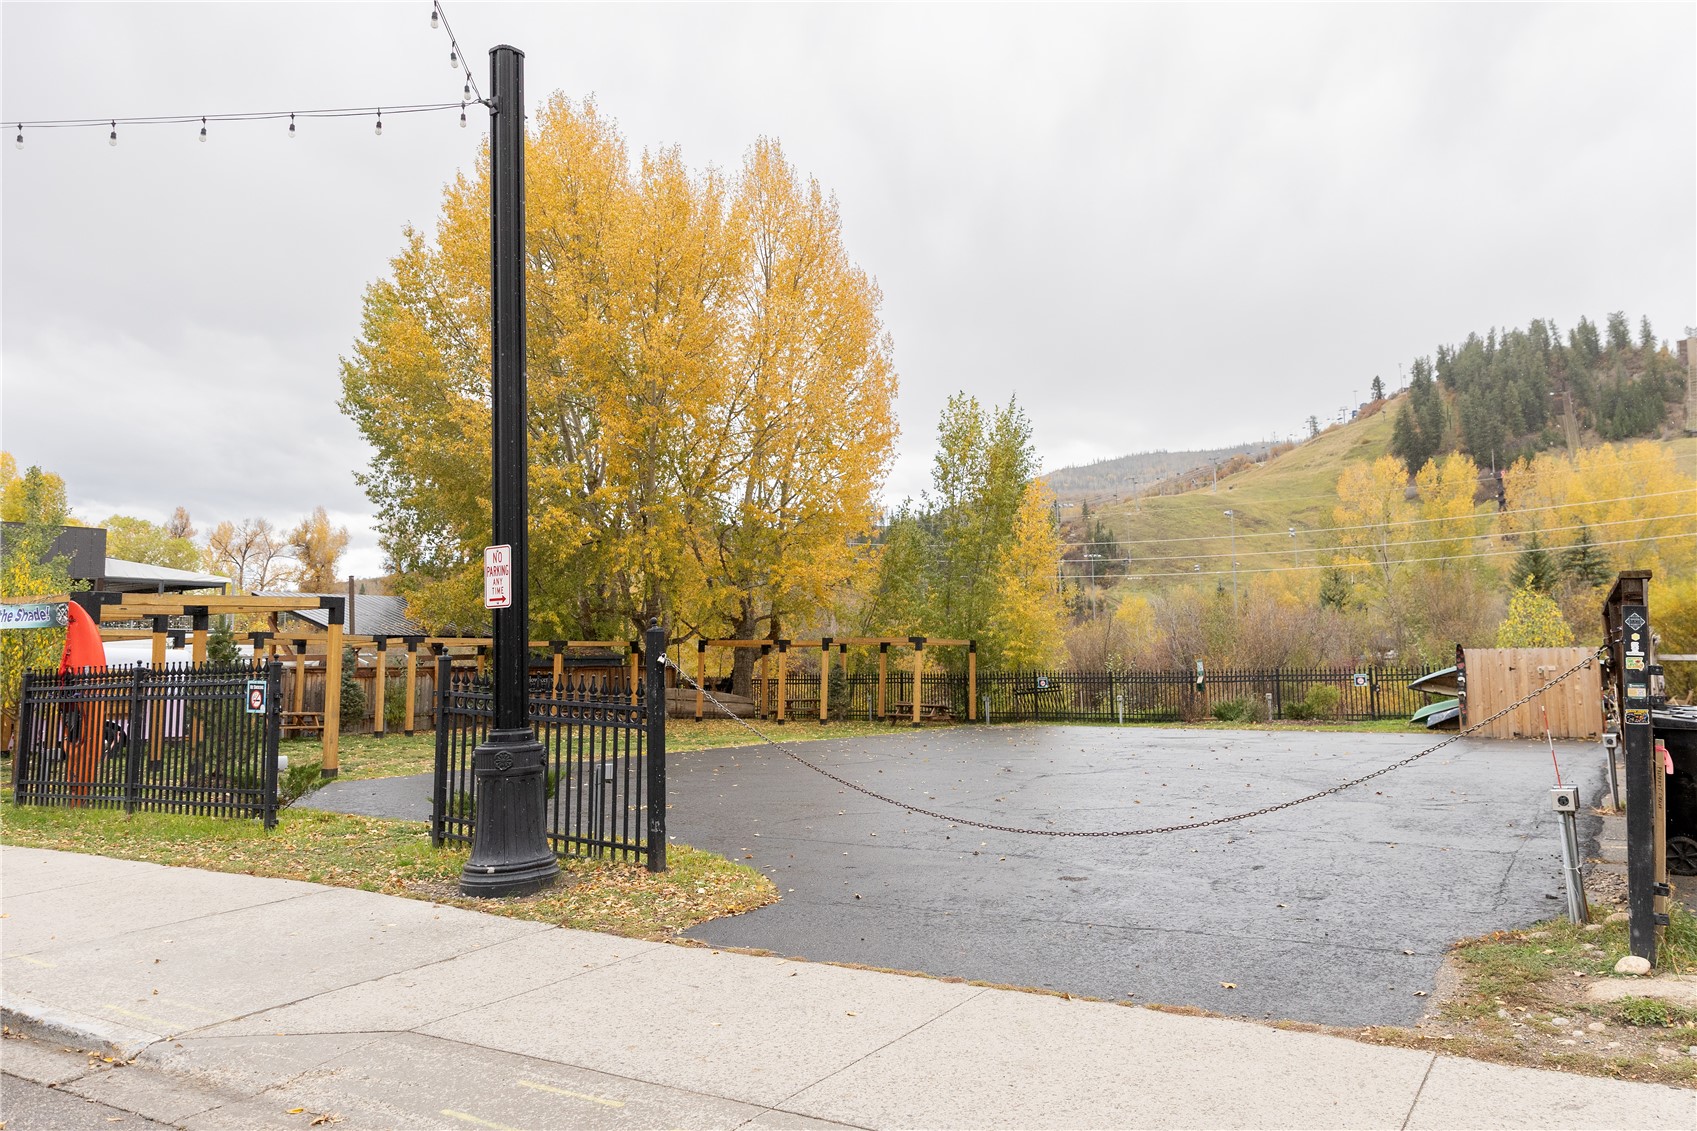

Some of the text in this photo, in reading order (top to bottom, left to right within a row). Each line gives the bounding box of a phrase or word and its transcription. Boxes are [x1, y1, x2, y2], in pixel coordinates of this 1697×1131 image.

[492, 551, 503, 563] NO
[486, 564, 509, 577] PARKING
[492, 578, 503, 586] ANY
[491, 586, 504, 595] TIME
[15, 606, 50, 621] Shade!
